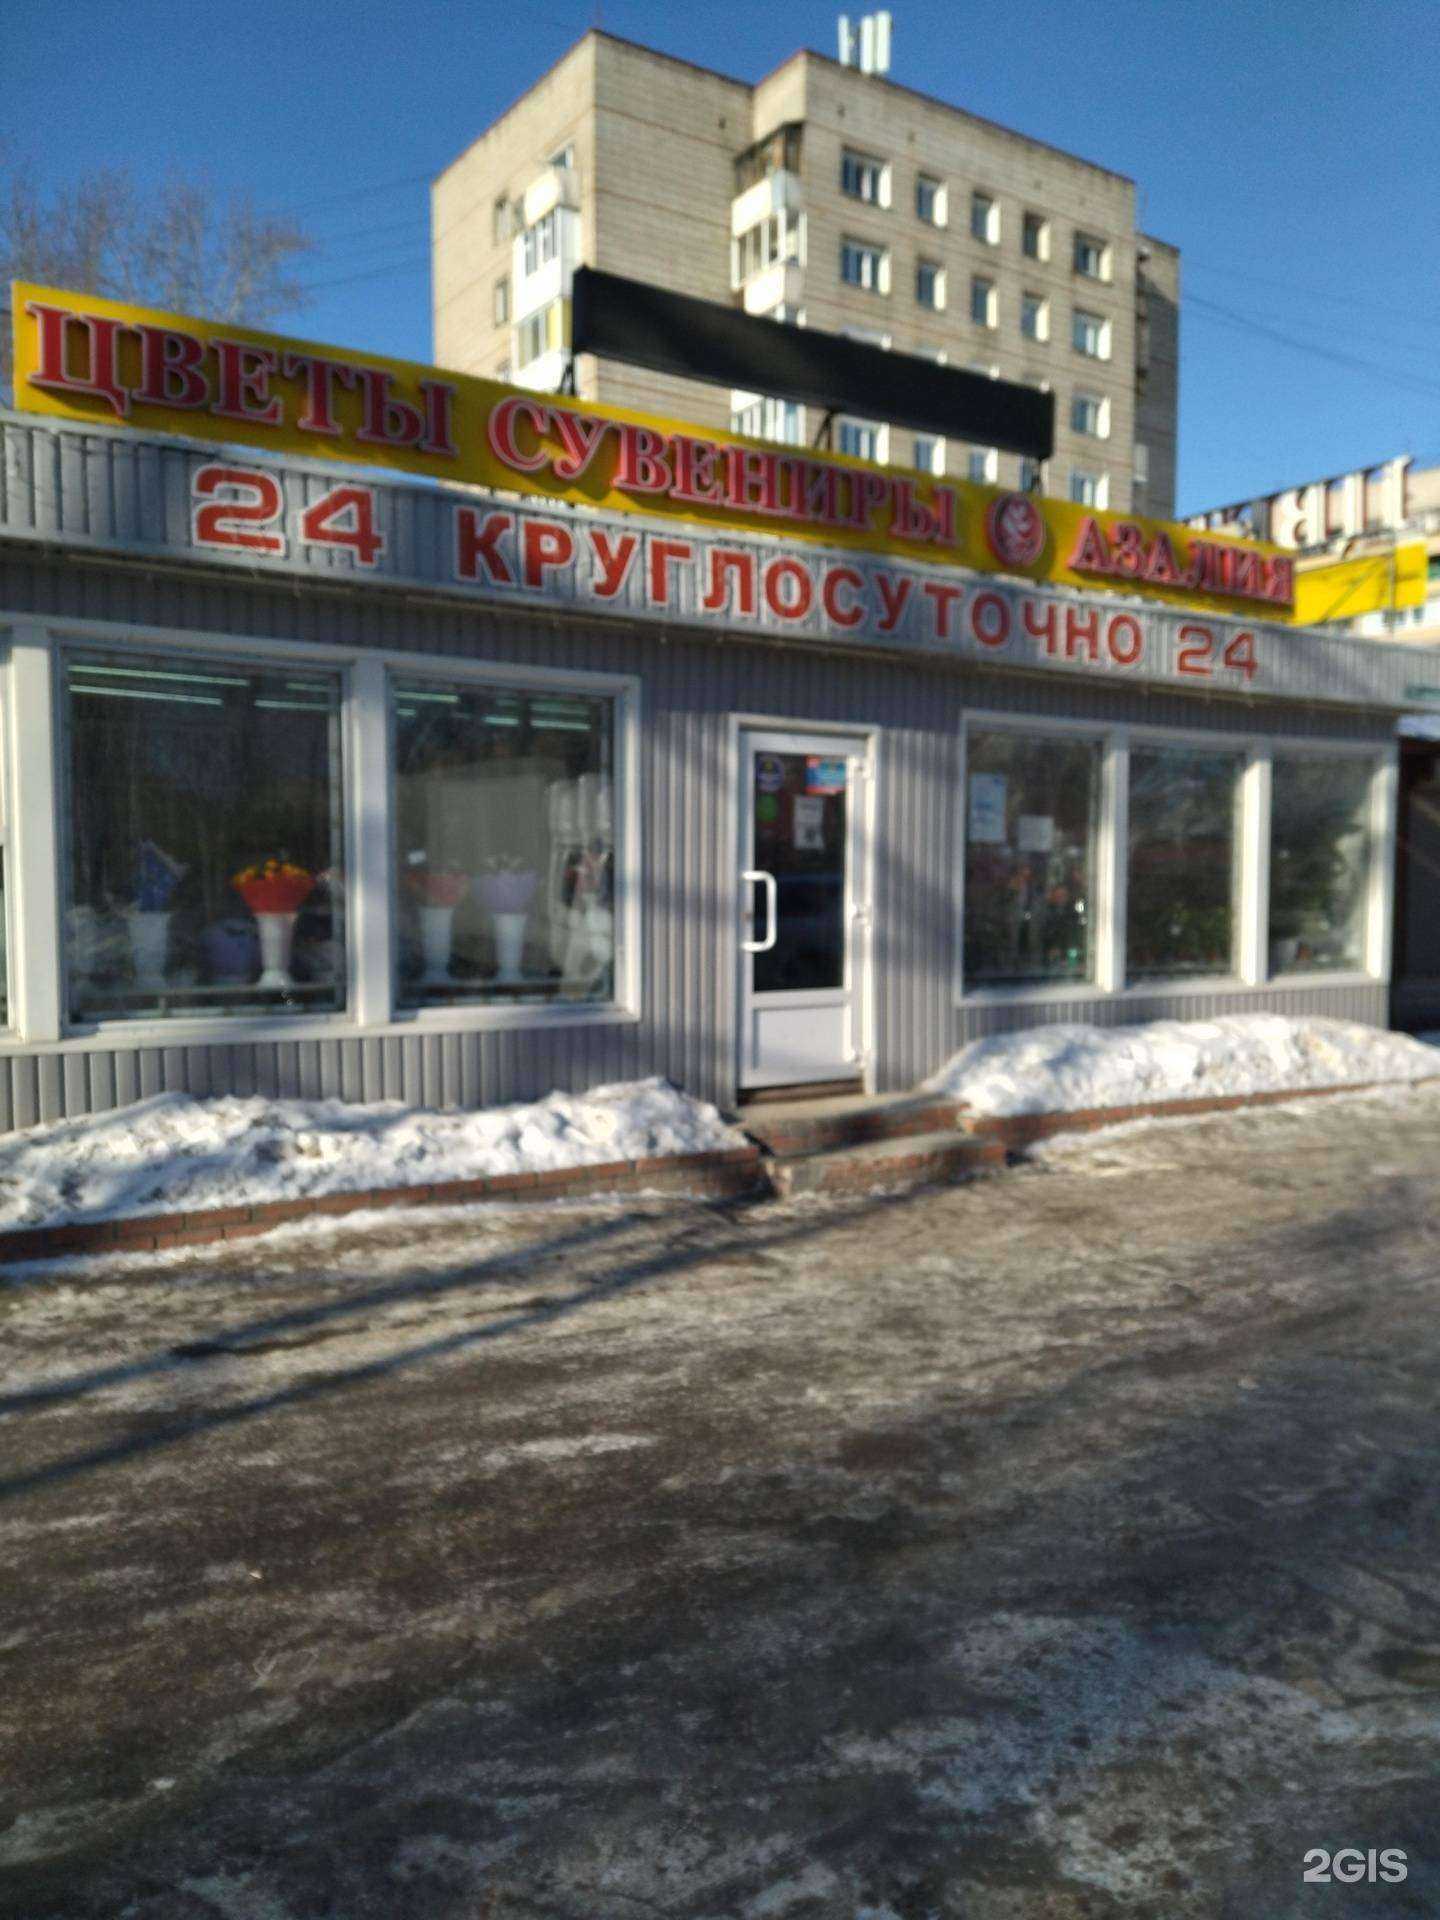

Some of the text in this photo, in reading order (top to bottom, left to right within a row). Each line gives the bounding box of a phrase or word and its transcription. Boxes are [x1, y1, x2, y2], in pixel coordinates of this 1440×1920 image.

[26, 303, 1295, 604] ЦВЕТЫ СУВЕНИРЫ АЗАЛИЯ
[194, 467, 1258, 681] 24 КРУГЛОСУТОЧНО 24
